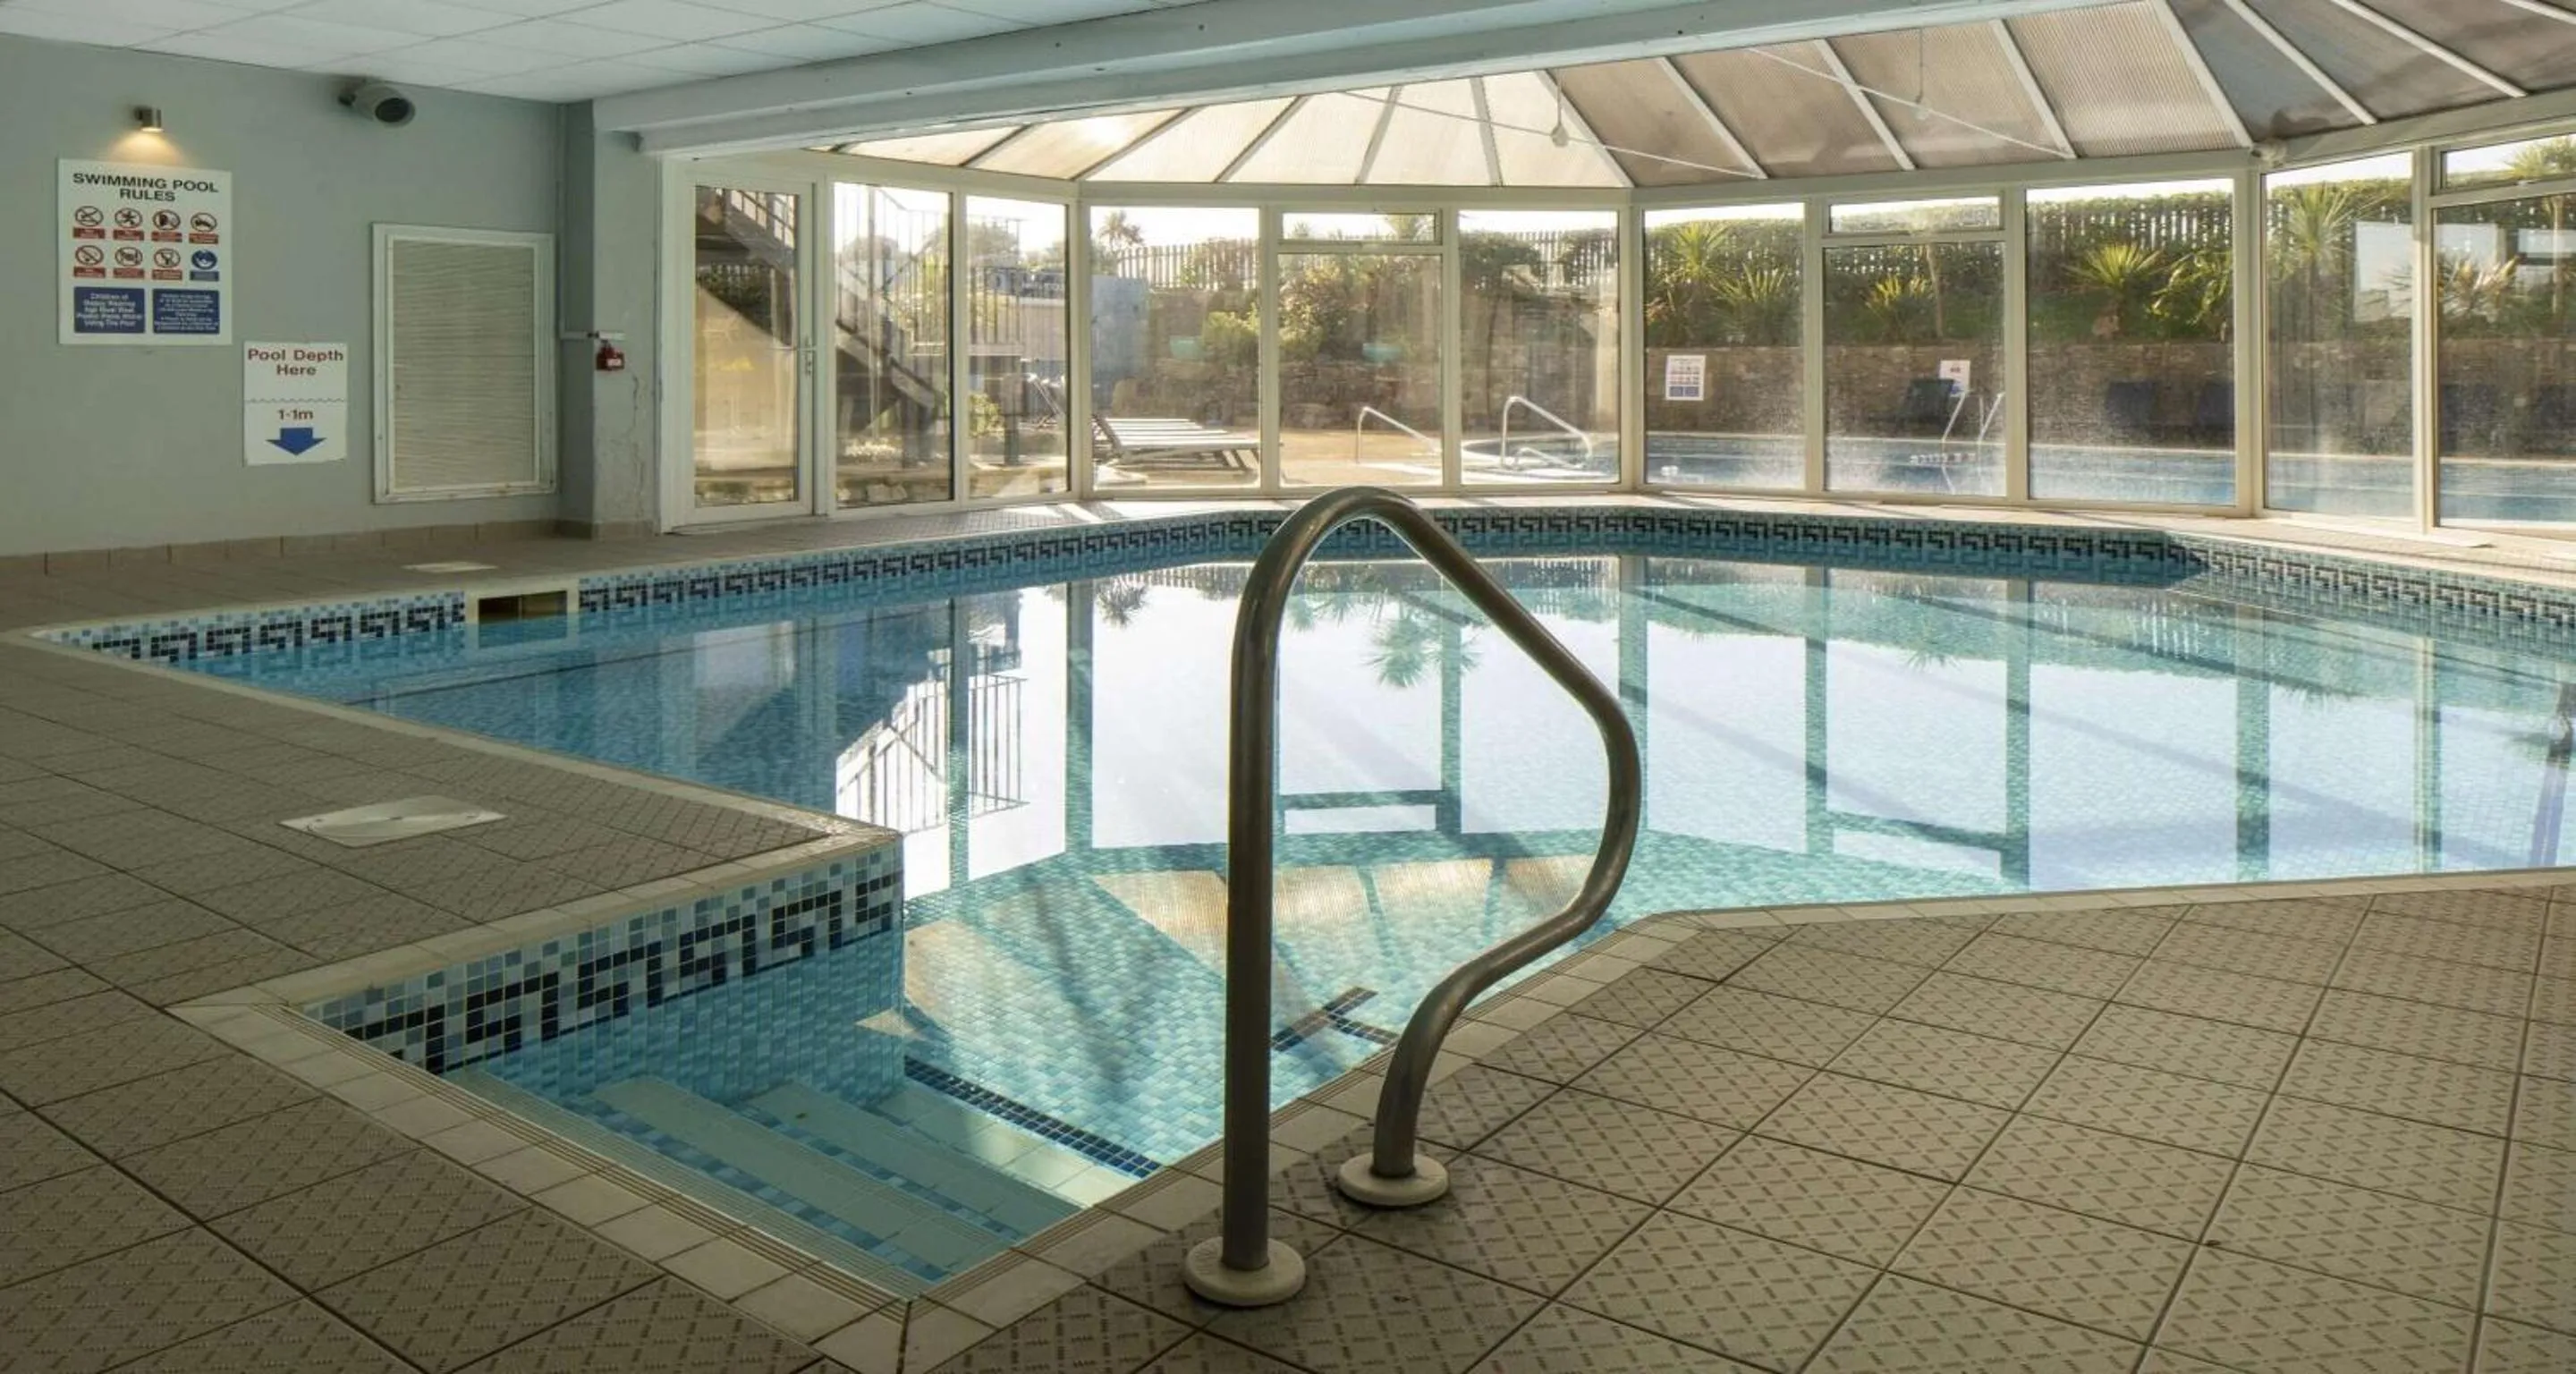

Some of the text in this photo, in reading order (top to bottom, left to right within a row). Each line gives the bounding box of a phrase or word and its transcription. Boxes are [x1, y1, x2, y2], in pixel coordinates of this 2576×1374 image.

[73, 172, 219, 193] SWIMMING POOL
[120, 188, 176, 202] RULES
[248, 348, 344, 362] Pool Depth
[276, 364, 317, 376] Here
